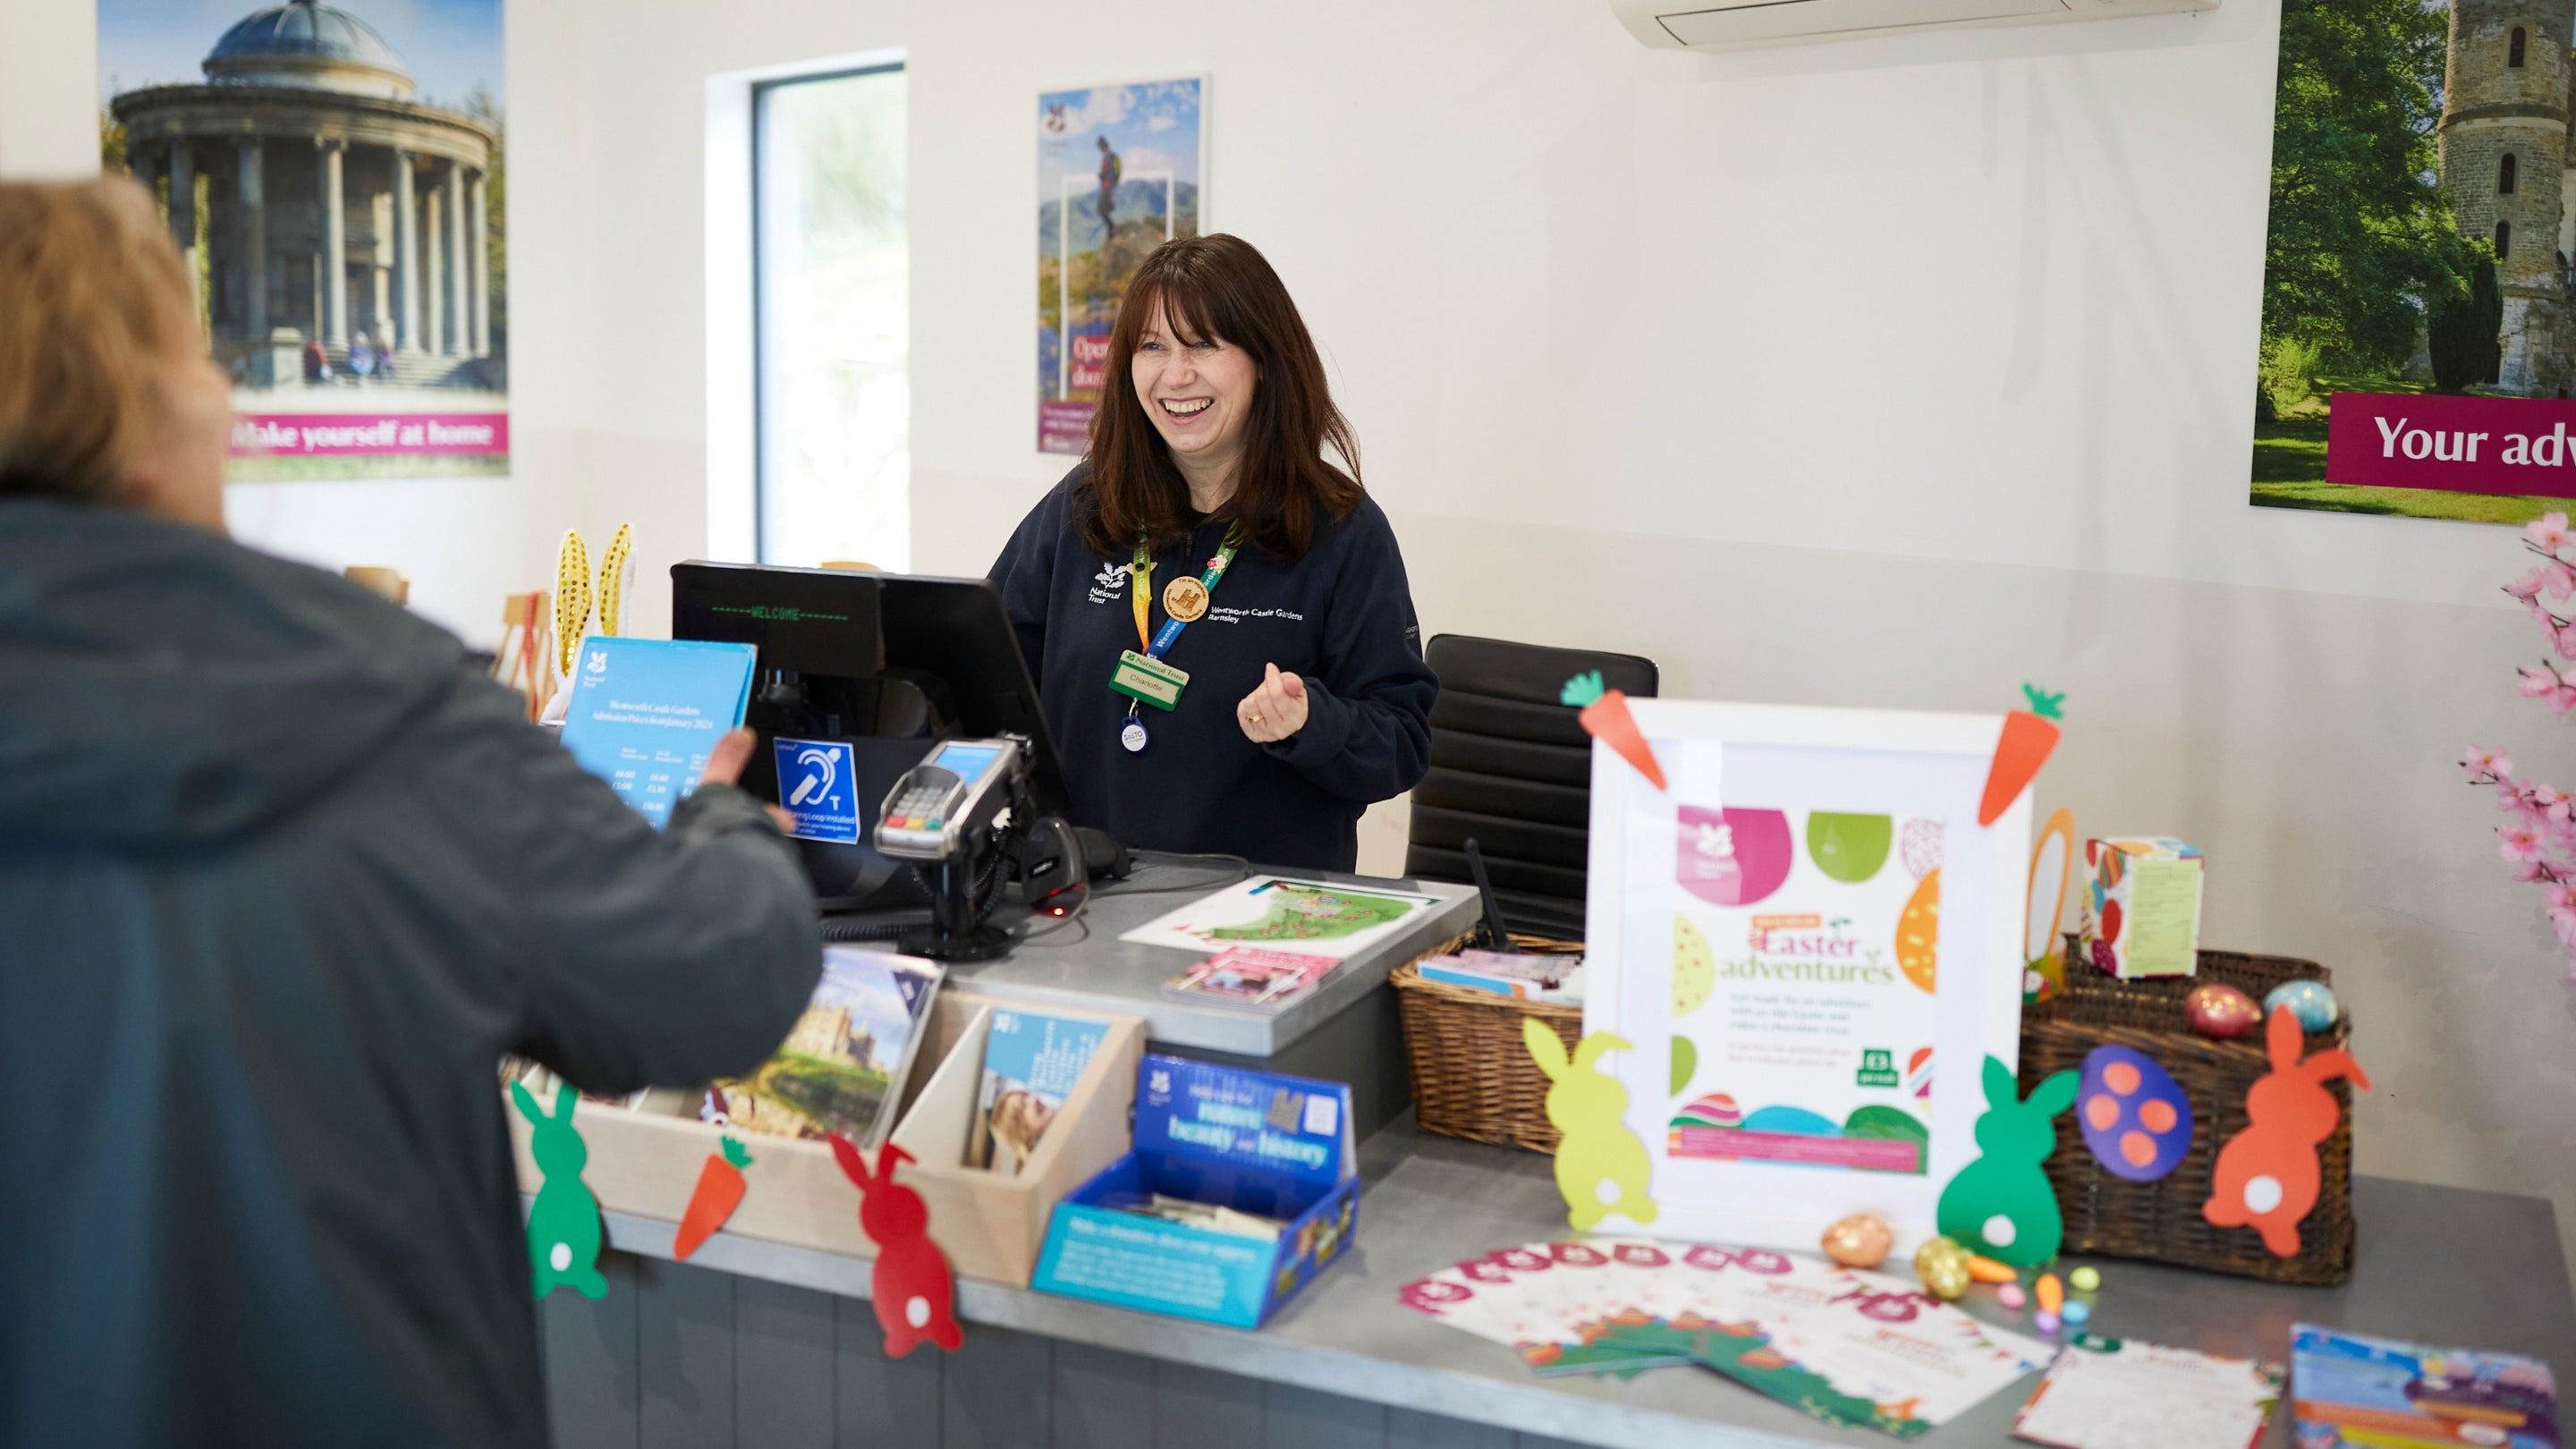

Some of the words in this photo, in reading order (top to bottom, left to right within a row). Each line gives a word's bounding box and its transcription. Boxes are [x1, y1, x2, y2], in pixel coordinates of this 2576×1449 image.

[301, 419, 399, 453] yourself
[400, 424, 424, 446] at
[428, 419, 494, 445] home
[2374, 417, 2489, 462] Your
[1089, 594, 1106, 604] Trust
[1090, 587, 1121, 599] National
[1208, 614, 1240, 624] Barnsley
[1211, 606, 1250, 616] Wentworth
[1251, 608, 1274, 617] Castle
[1275, 608, 1303, 621] Gardens
[1136, 657, 1166, 674] National
[1167, 670, 1184, 682] Trust
[1130, 674, 1163, 691] Charlotte
[829, 795, 841, 811] T
[1762, 928, 1859, 956] Easter
[1721, 955, 1894, 982] adventures
